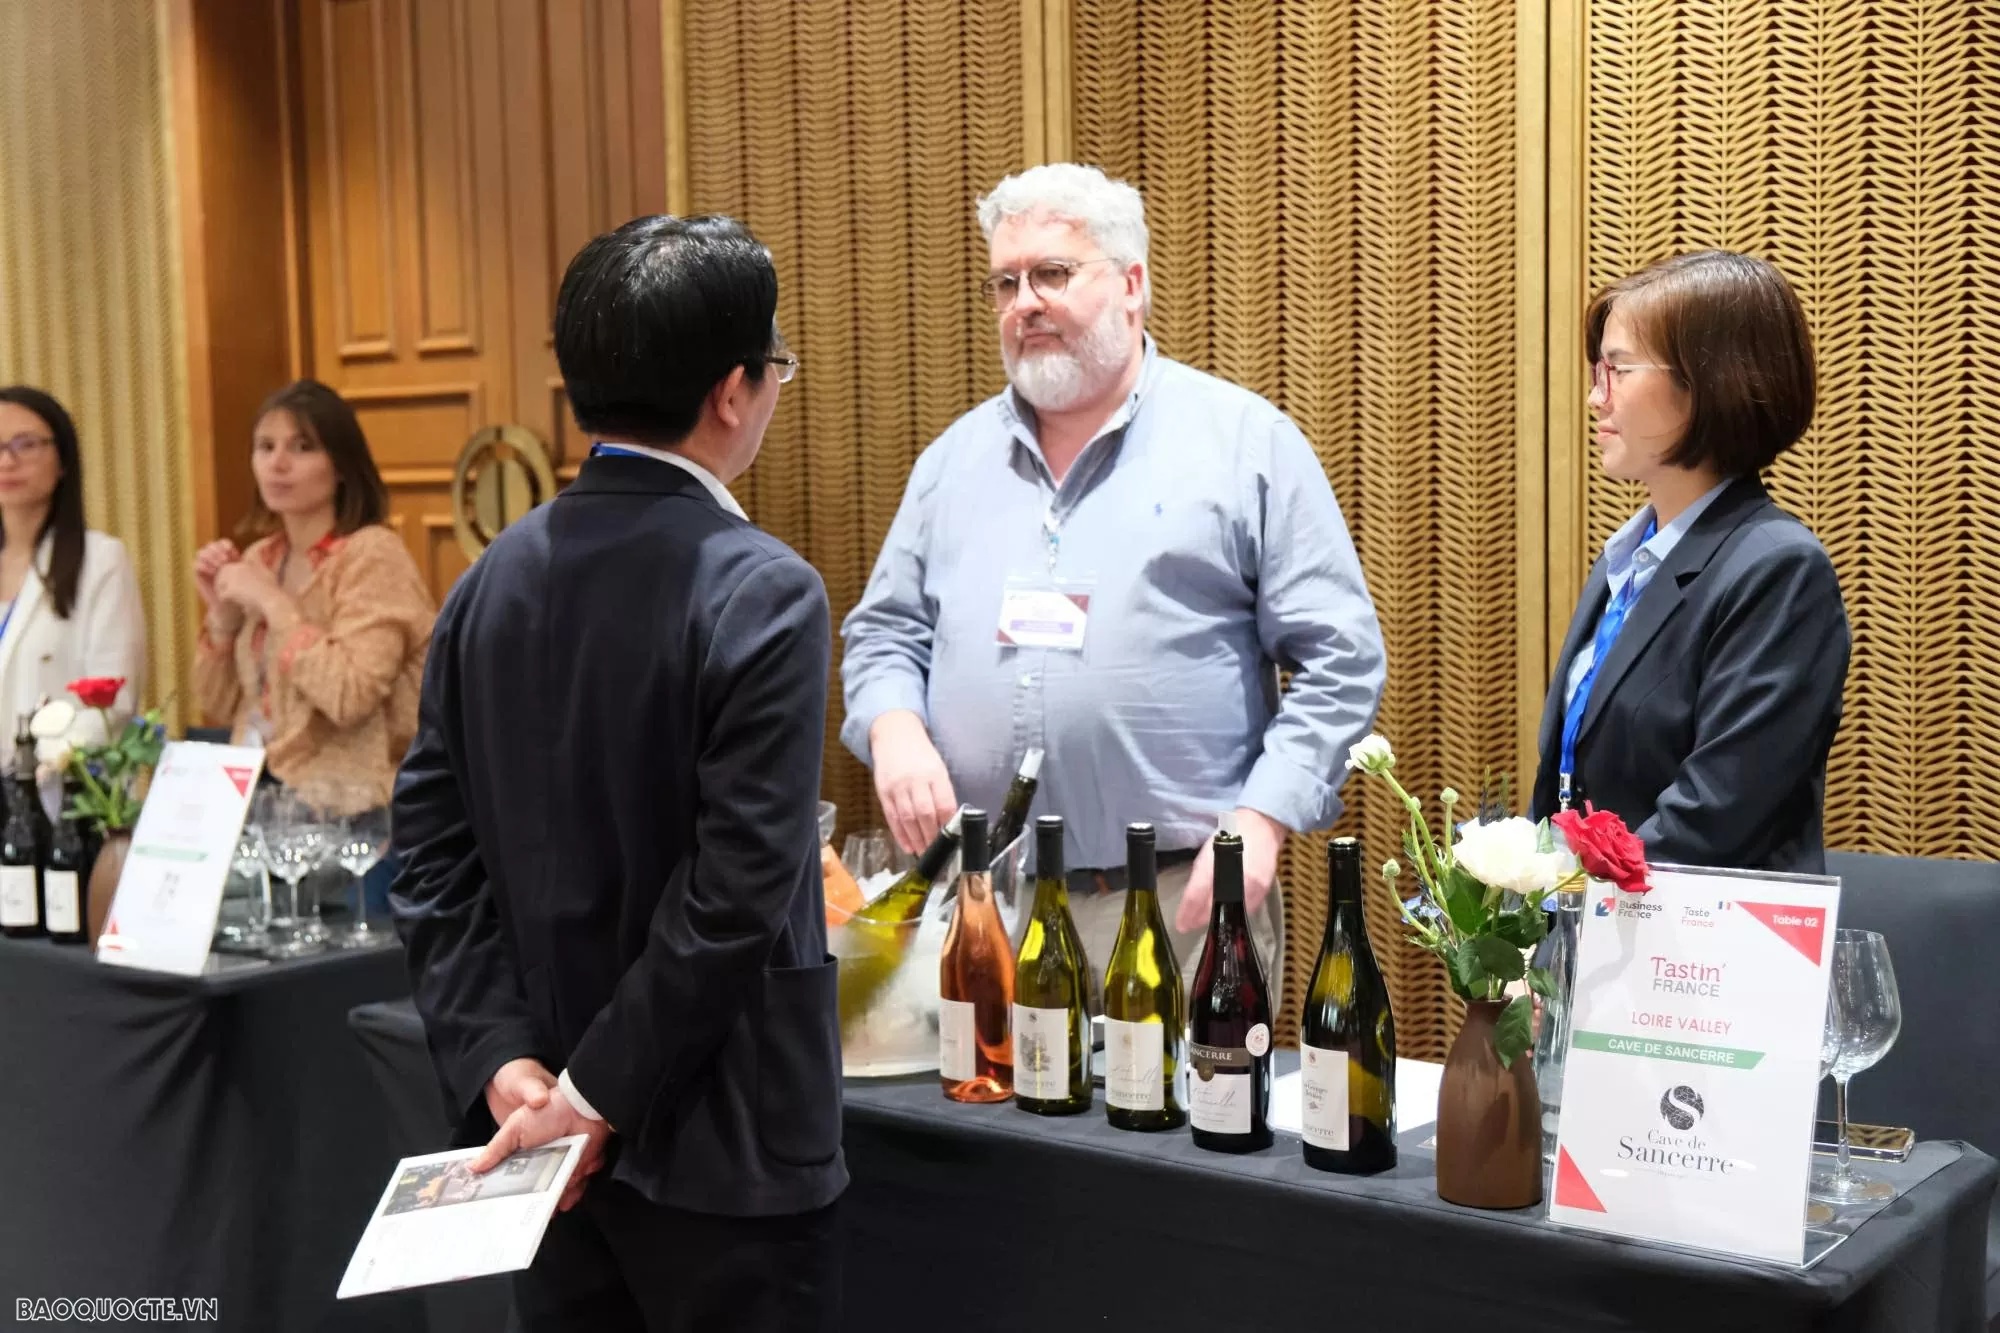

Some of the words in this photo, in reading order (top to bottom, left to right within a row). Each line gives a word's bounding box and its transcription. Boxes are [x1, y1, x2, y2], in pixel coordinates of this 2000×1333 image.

[1617, 908, 1652, 919] France
[1618, 900, 1663, 912] Business
[1684, 906, 1711, 918] Taste
[1681, 917, 1715, 928] France
[1772, 914, 1802, 927] Table
[1804, 916, 1818, 928] 02
[1652, 979, 1720, 997] FRANCE
[1632, 1011, 1673, 1028] LOIRE
[1678, 1017, 1732, 1035] VALLEY
[1608, 1038, 1642, 1052] CAVE
[1644, 1043, 1661, 1055] DE
[1664, 1045, 1735, 1063] SANCERRE
[1647, 1127, 1684, 1147] Cave
[1688, 1135, 1707, 1150] de
[1617, 1135, 1734, 1175] Sancerre
